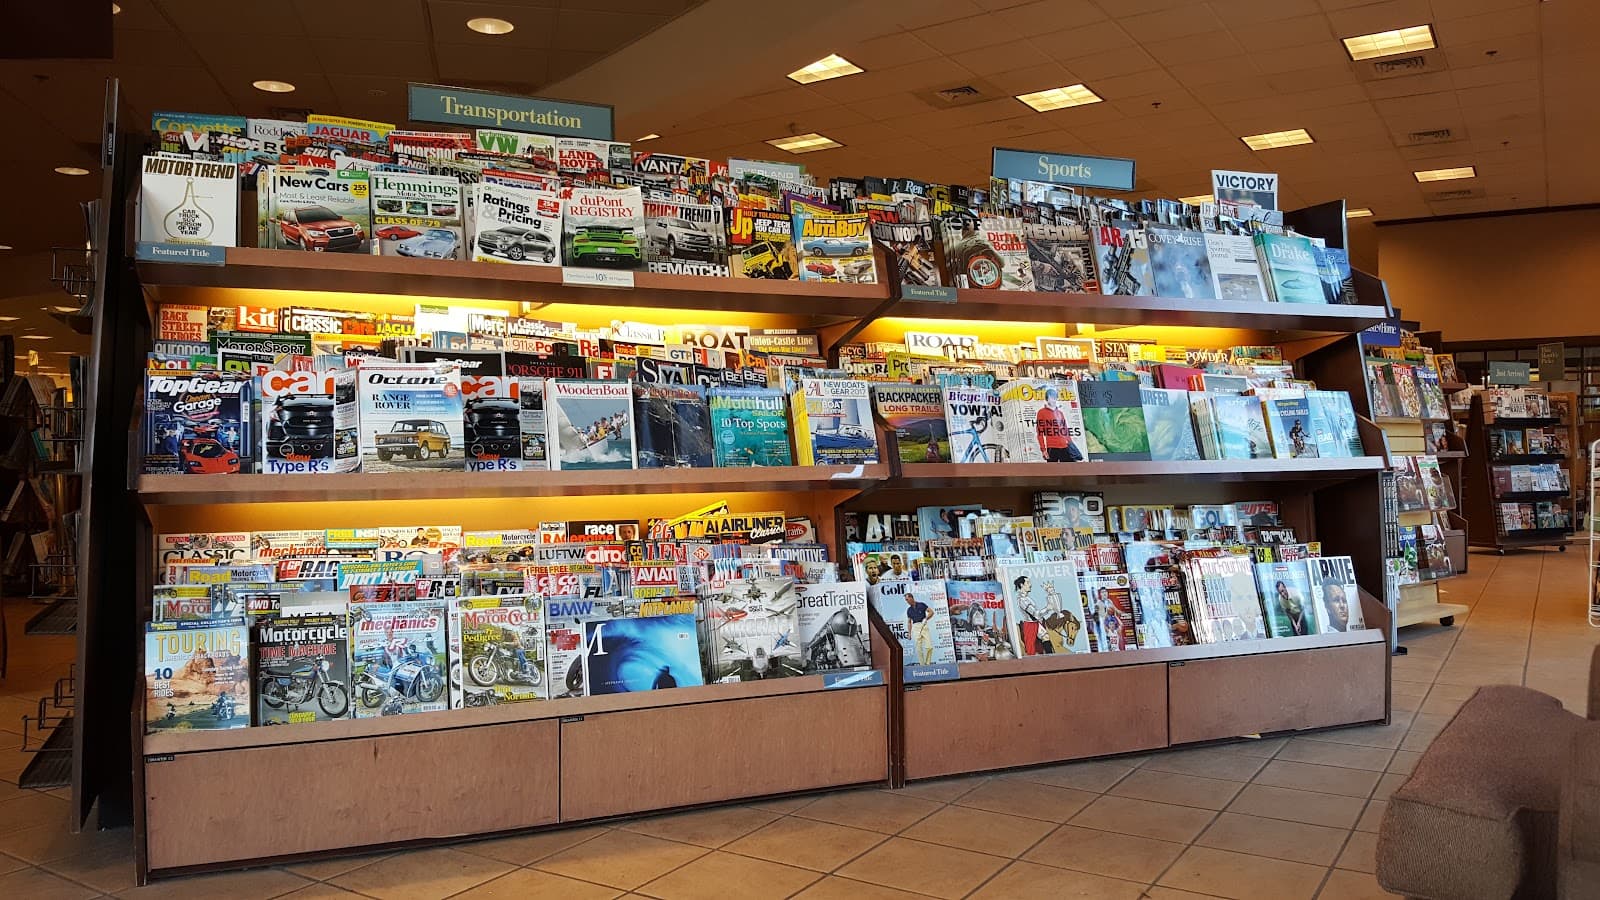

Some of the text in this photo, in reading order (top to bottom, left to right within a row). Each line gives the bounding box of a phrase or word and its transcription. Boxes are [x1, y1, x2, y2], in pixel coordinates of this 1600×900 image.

[440, 95, 582, 129] Transportation
[312, 125, 371, 141] JAGUAR
[479, 134, 519, 154] VW
[558, 150, 597, 161] LAND
[145, 157, 235, 180] MOTOR TREND
[560, 159, 605, 169] ROVER
[1038, 155, 1092, 181] Sports
[280, 175, 349, 192] New Cars
[353, 184, 367, 192] 255
[374, 177, 458, 196] Hemmings
[1216, 174, 1274, 190] VICTORY
[483, 192, 530, 213] Ratings
[580, 195, 624, 209] duPont
[498, 207, 542, 229] Pricing
[570, 206, 635, 219] REGISTRY
[642, 202, 712, 223] TRUCK TREND
[375, 217, 406, 226] CLASS
[409, 218, 422, 227] OF
[730, 208, 753, 240] Jp
[754, 218, 791, 228] JEEP TECH
[755, 225, 791, 235] YOU CAN DO
[1022, 222, 1090, 241] RECOIL
[987, 231, 1015, 244] Dirty
[1148, 232, 1204, 247] COVEY RISE
[152, 246, 210, 258] Featured Title
[993, 241, 1027, 251] Bomb
[1271, 243, 1310, 259] Drake
[910, 288, 947, 297] Featured Title
[162, 310, 188, 321] BACK
[239, 306, 278, 328] kit
[162, 321, 203, 332] STREET
[682, 330, 748, 350] BOAT
[508, 365, 565, 378] ORSCHE
[847, 363, 873, 375] DIRT
[150, 375, 243, 396] TopGear
[262, 370, 336, 396] car
[368, 372, 448, 386] Octane
[823, 381, 841, 389] NEW
[556, 383, 629, 396] WoodenBoat
[830, 388, 867, 396] GEAR 2017
[372, 393, 410, 402] RANGE
[717, 395, 784, 410] Multihull
[878, 392, 940, 403] BACKPACKER
[173, 397, 222, 413] Garage
[375, 401, 411, 410] ROVER
[822, 401, 844, 409] BOAT
[884, 404, 940, 413] LONG TRAILS
[721, 417, 786, 431] 10 Top Spots
[1026, 419, 1046, 428] THE
[1038, 427, 1082, 437] HEROES
[268, 459, 329, 474] Type R's
[497, 458, 517, 471] R's
[584, 524, 615, 535] race
[721, 517, 784, 532] AIRLINER
[502, 533, 537, 541] Motorcycle
[1311, 557, 1355, 586] ARNIE
[881, 583, 906, 596] Golf
[960, 591, 996, 602] Sports
[247, 599, 269, 610] 4WD
[549, 601, 593, 616] BMW
[360, 617, 437, 633] mechanics
[888, 623, 905, 632] THE
[259, 626, 347, 645] Motorcycle
[463, 634, 501, 643] Pedigree
[156, 628, 241, 662] TOURING
[259, 642, 337, 659] TIME MACHINE
[154, 667, 173, 680] 10
[154, 680, 171, 689] BEST
[154, 689, 174, 698] RIDES
